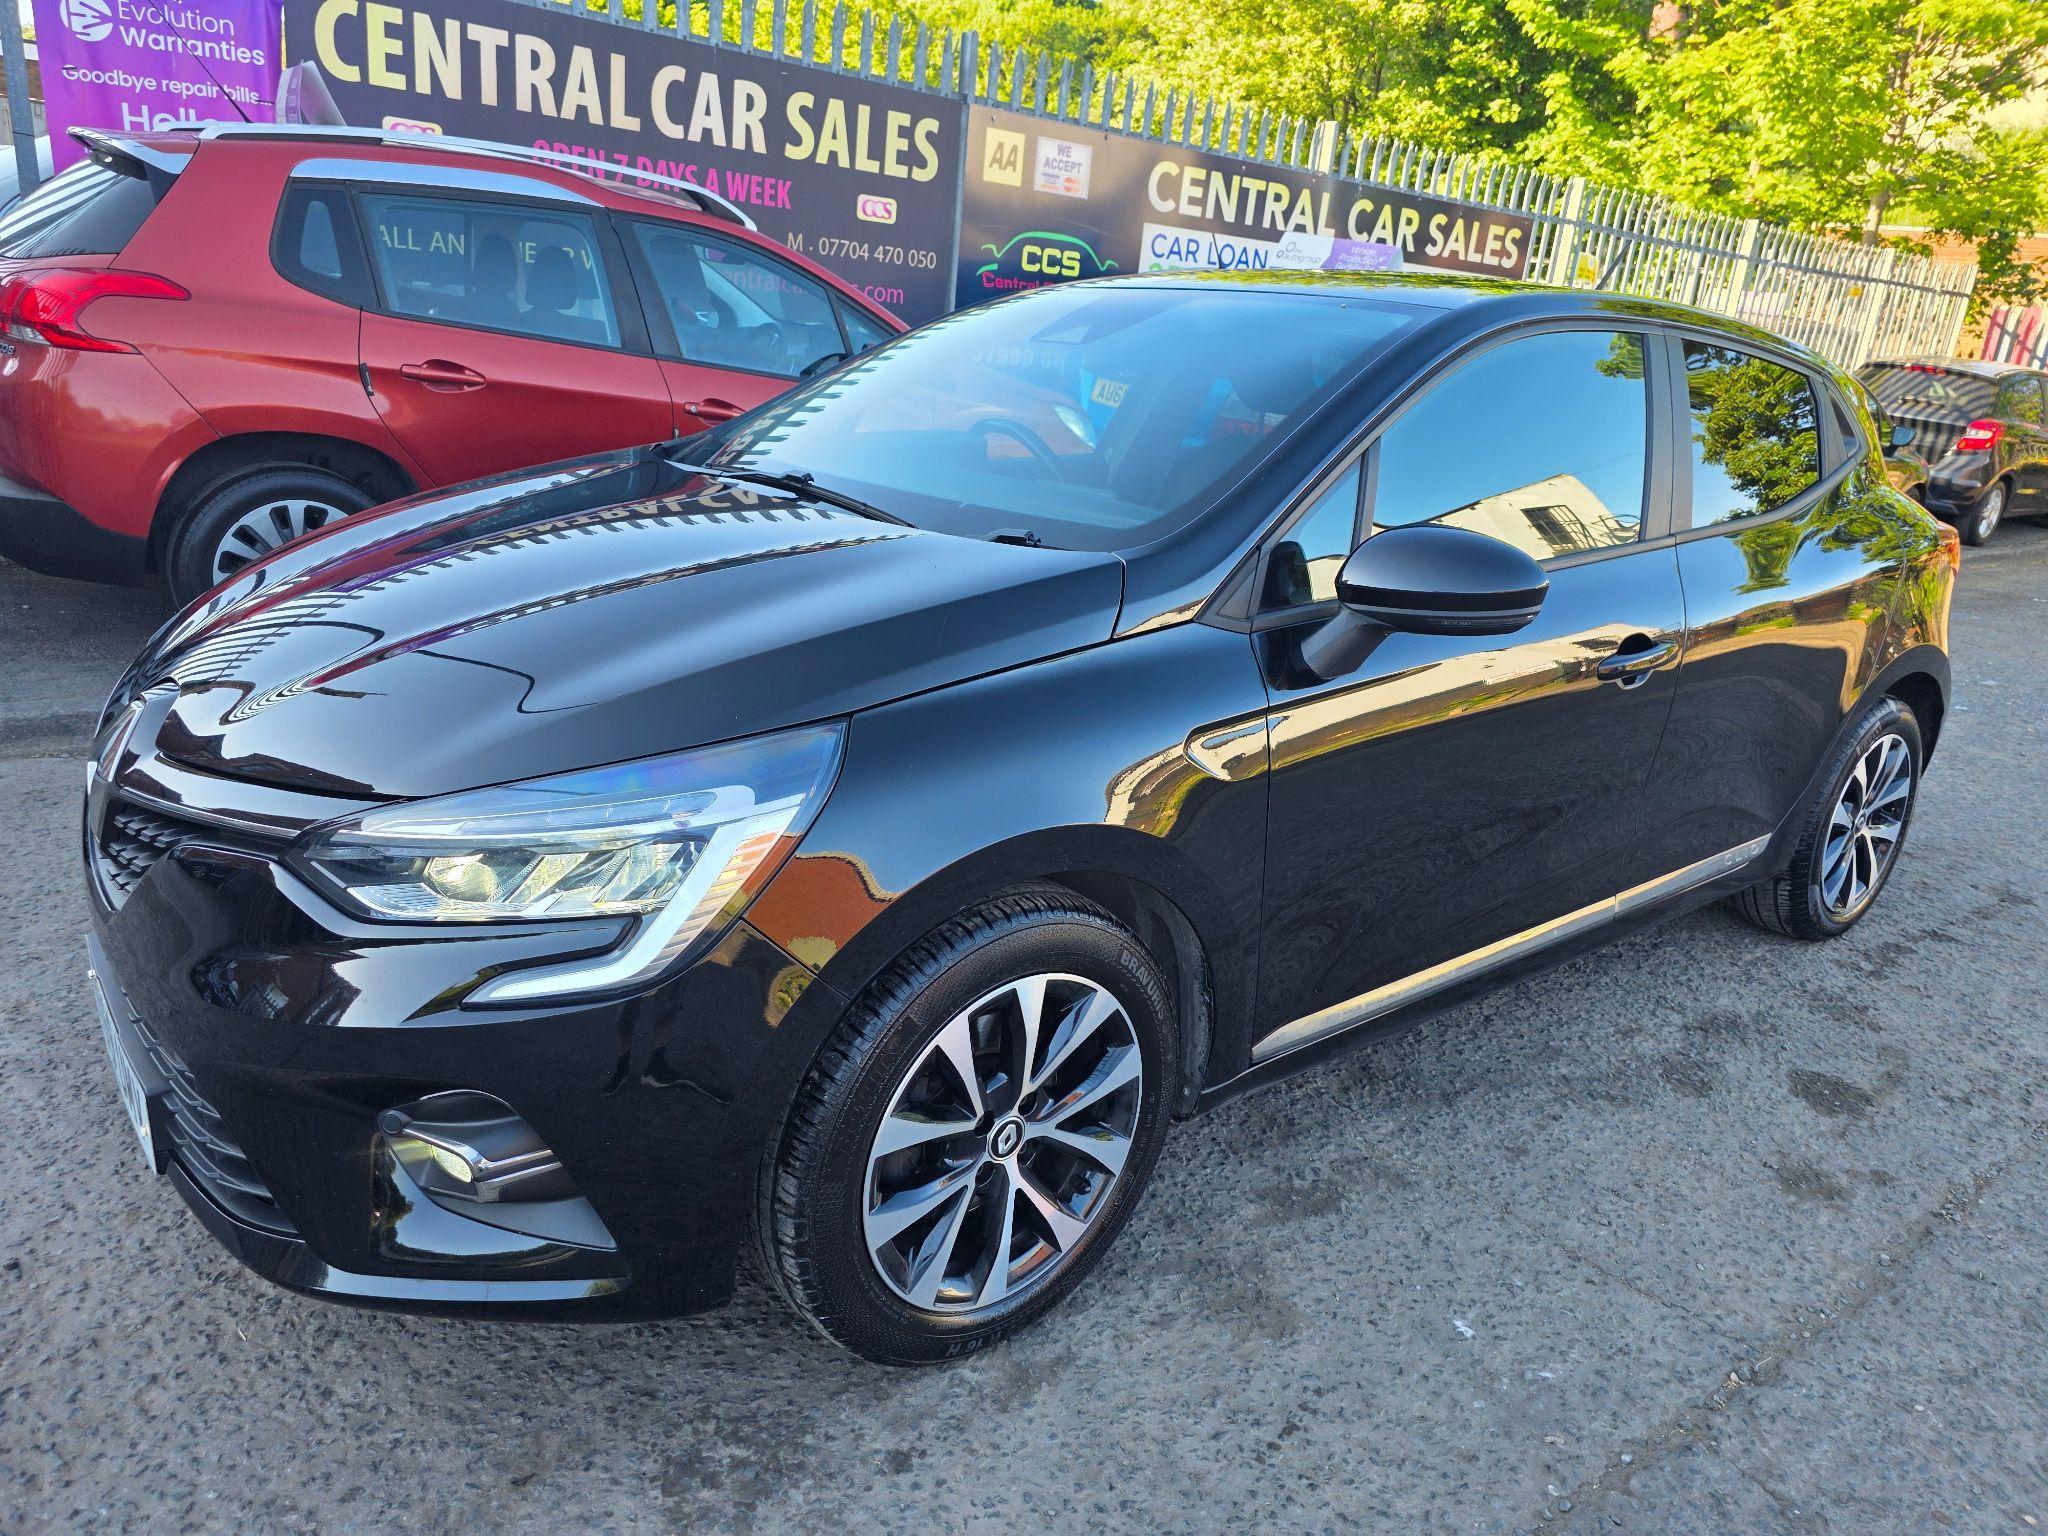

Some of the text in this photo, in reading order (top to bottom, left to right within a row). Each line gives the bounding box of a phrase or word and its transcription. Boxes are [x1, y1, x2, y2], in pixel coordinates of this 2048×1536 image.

[118, 0, 235, 36] Evolution
[118, 25, 266, 65] Warranties
[62, 64, 157, 93] Goodbye
[162, 78, 219, 99] repair
[314, 0, 641, 132] CENTRAL
[651, 64, 767, 154] CAR
[784, 91, 940, 182] SALES
[988, 141, 1018, 173] AA
[1043, 155, 1082, 176] ACCEPT
[1057, 144, 1072, 158] WE
[705, 168, 720, 193] A
[726, 170, 793, 210] WEEK
[1148, 161, 1336, 238] CENTRAL
[1347, 198, 1420, 253] CAR
[1424, 212, 1523, 270] SALES
[819, 237, 868, 260] 07704
[874, 246, 903, 264] 470
[908, 250, 937, 269] 050
[1021, 244, 1081, 277] CCS
[1151, 233, 1268, 269] CAR LOAN
[982, 271, 1039, 289] Central
